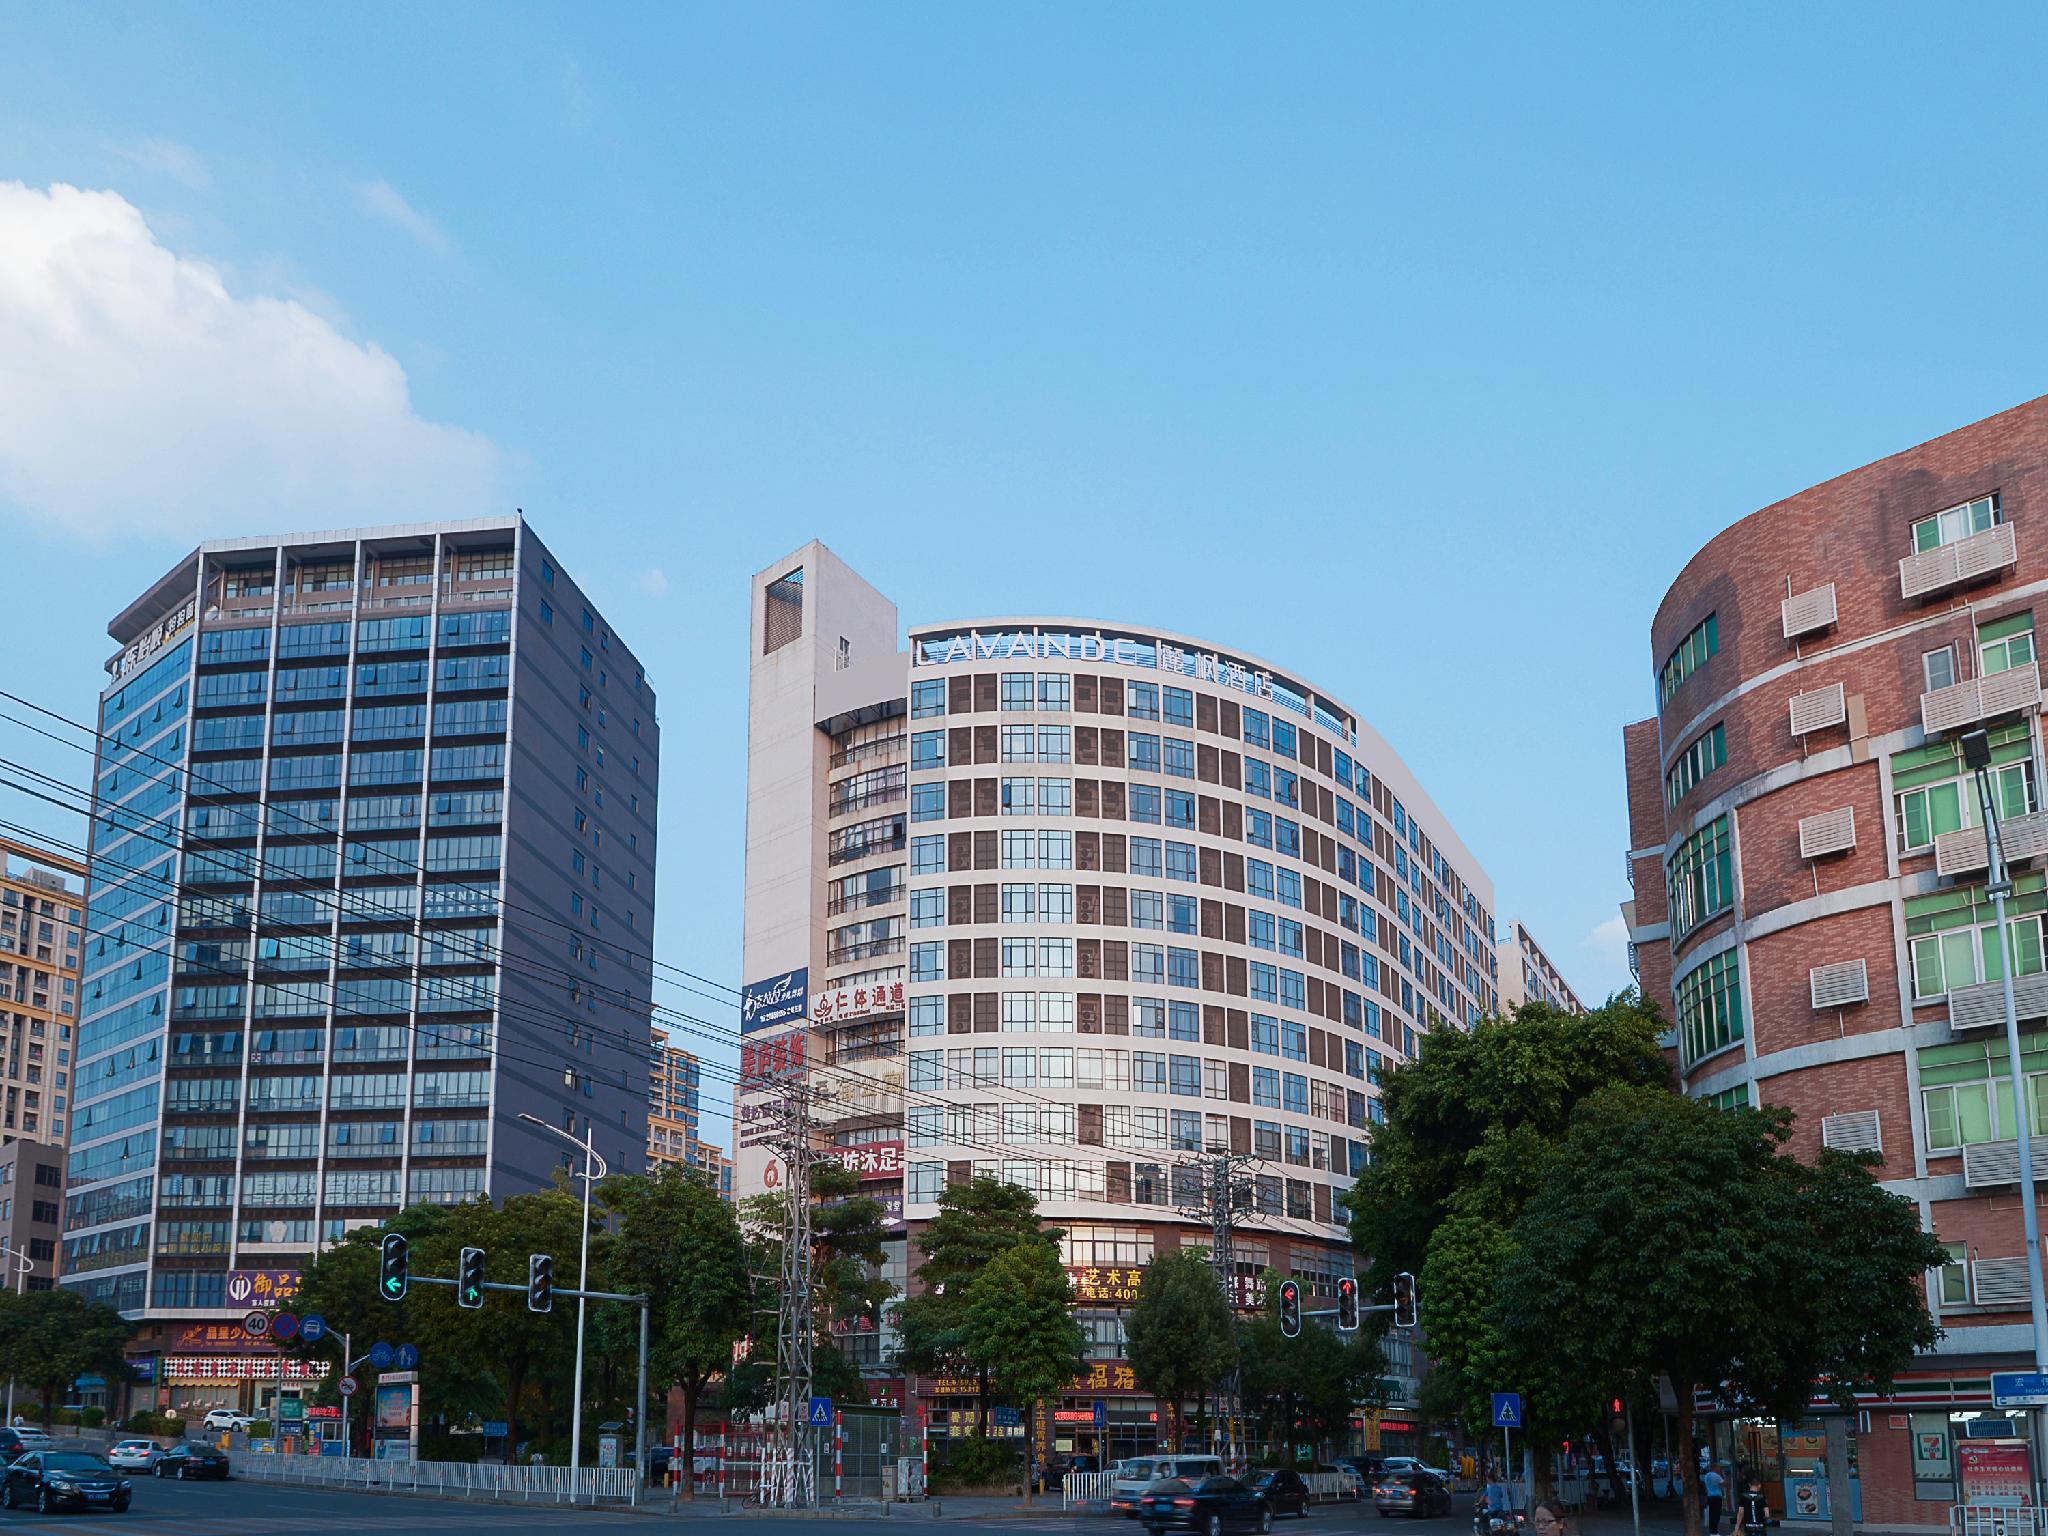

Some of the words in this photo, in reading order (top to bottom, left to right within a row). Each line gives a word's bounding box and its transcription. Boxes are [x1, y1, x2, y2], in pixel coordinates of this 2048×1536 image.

[917, 630, 1137, 666] LAVANDE
[835, 982, 904, 1011] 仁体通道
[248, 1318, 265, 1330] 40
